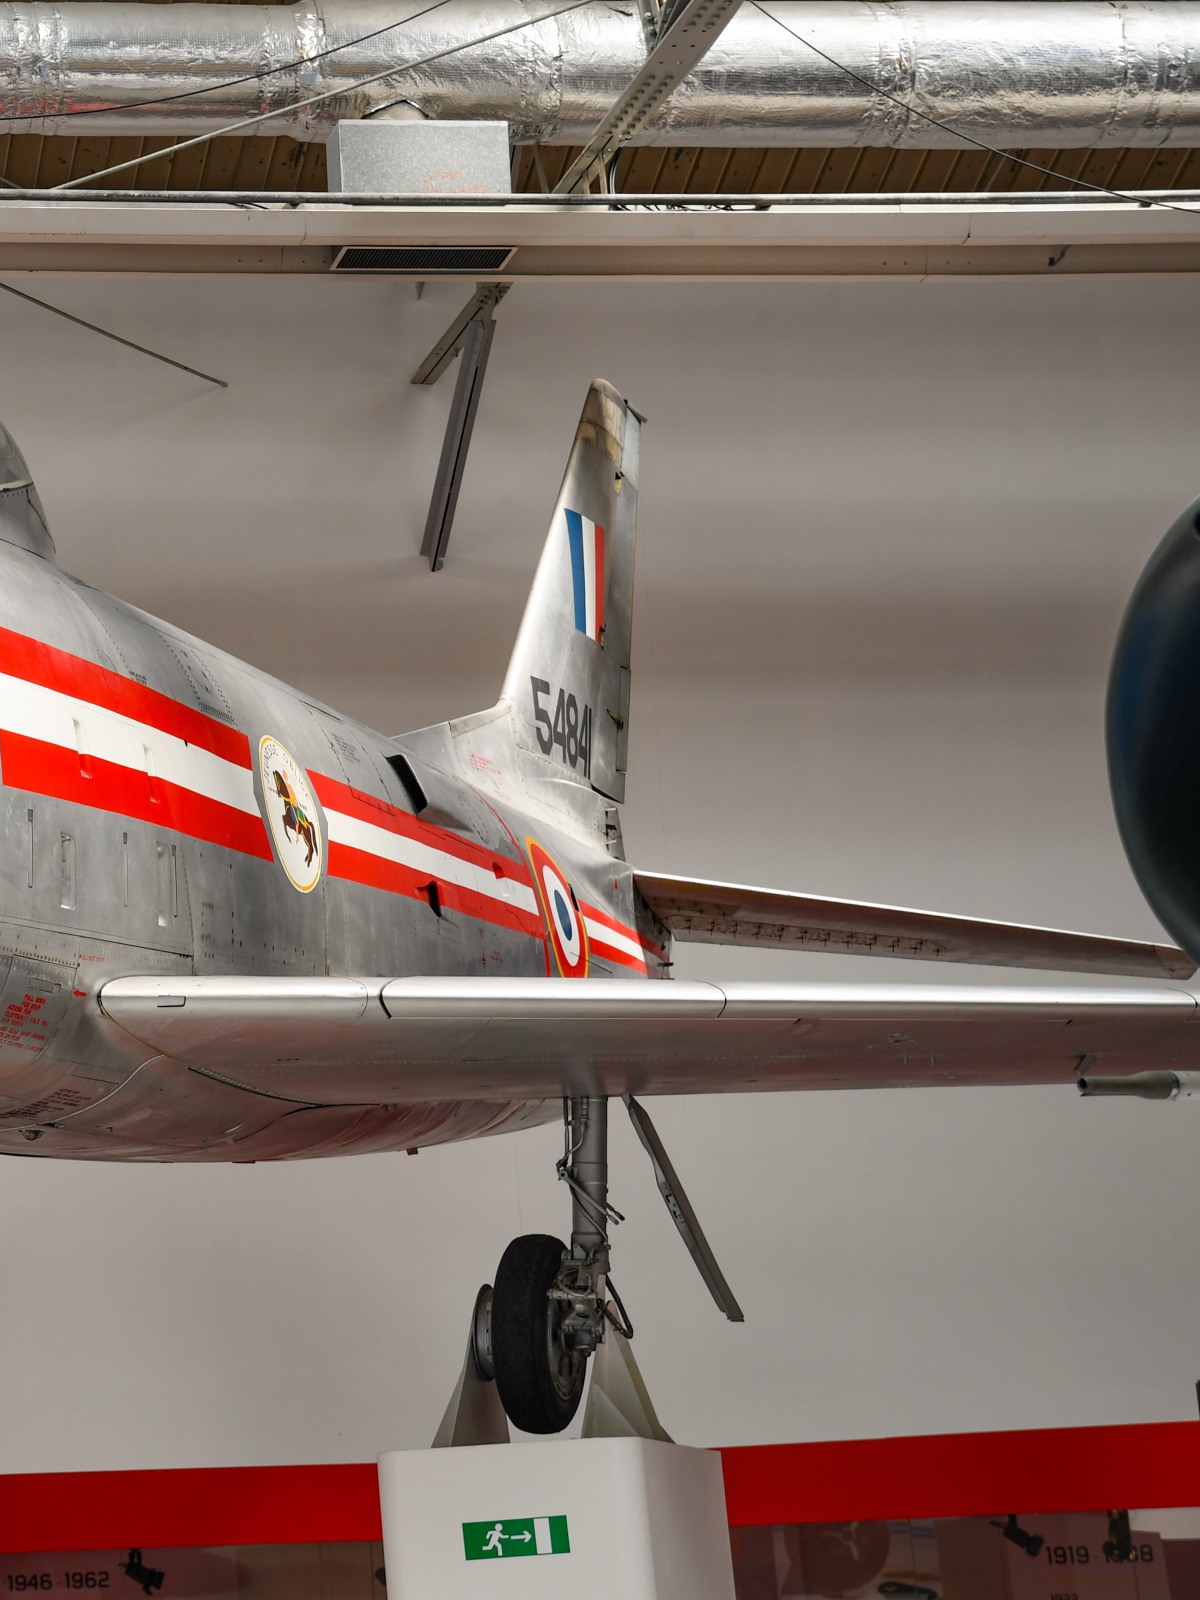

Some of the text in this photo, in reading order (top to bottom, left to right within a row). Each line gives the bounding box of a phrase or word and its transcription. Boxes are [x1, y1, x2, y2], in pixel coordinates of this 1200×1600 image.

[1046, 1546, 1090, 1564] 1919
[8, 1574, 52, 1592] 1946
[64, 1571, 110, 1590] 1962
